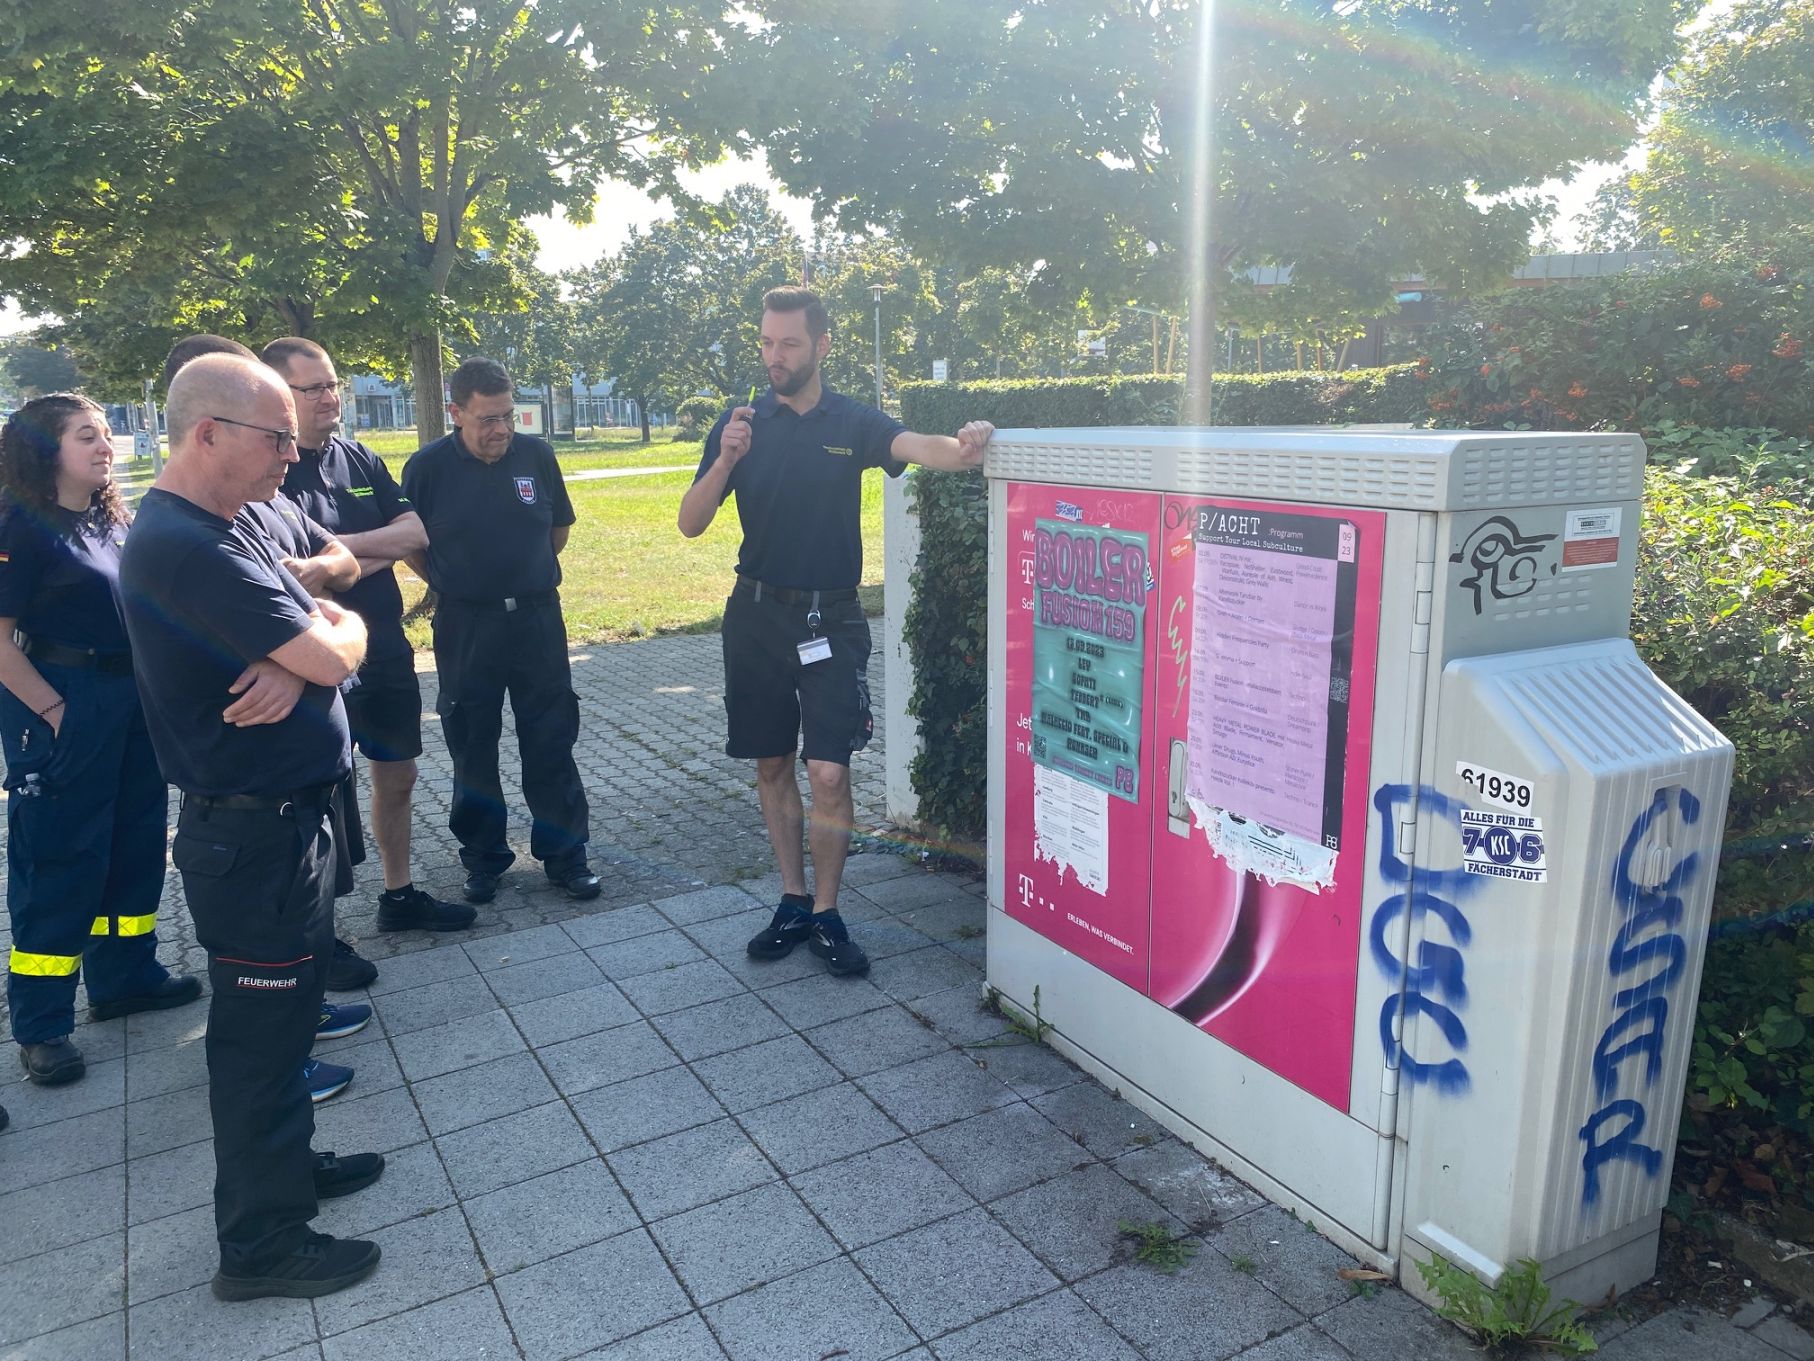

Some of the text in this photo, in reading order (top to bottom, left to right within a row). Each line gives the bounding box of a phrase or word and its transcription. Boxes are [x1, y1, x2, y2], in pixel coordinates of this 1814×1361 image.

[1199, 512, 1260, 535] P/ACHT
[1198, 533, 1304, 552] Support Your Local Subculture
[1342, 546, 1351, 556] 23
[1035, 527, 1146, 607] BOILER
[1041, 590, 1136, 642] FUSION 159
[1461, 768, 1530, 808] 61939
[1463, 812, 1534, 828] ALLES FÜR DIE
[1490, 835, 1510, 856] KSC
[1468, 862, 1542, 881] FÄCHERSTADT
[1090, 925, 1104, 939] WAS
[1103, 930, 1134, 956] VERBINDET.
[238, 976, 297, 988] FEUERWEHR
